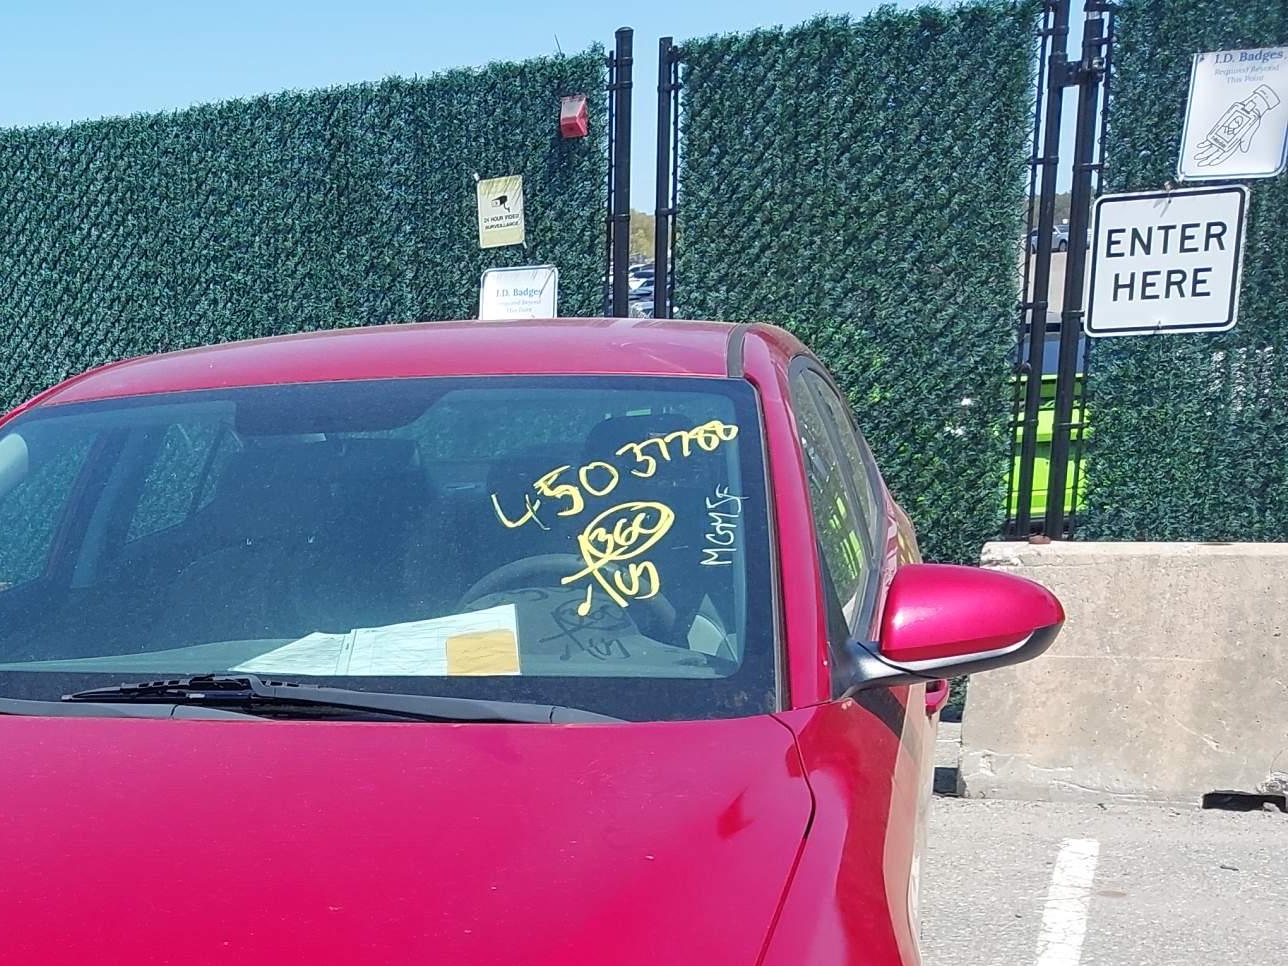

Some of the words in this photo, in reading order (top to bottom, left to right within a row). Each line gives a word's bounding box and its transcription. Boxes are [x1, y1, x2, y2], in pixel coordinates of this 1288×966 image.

[1215, 53, 1235, 64] I.D.
[1239, 50, 1284, 63] Badges
[1105, 221, 1228, 258] ENTER
[1112, 267, 1213, 302] HERE
